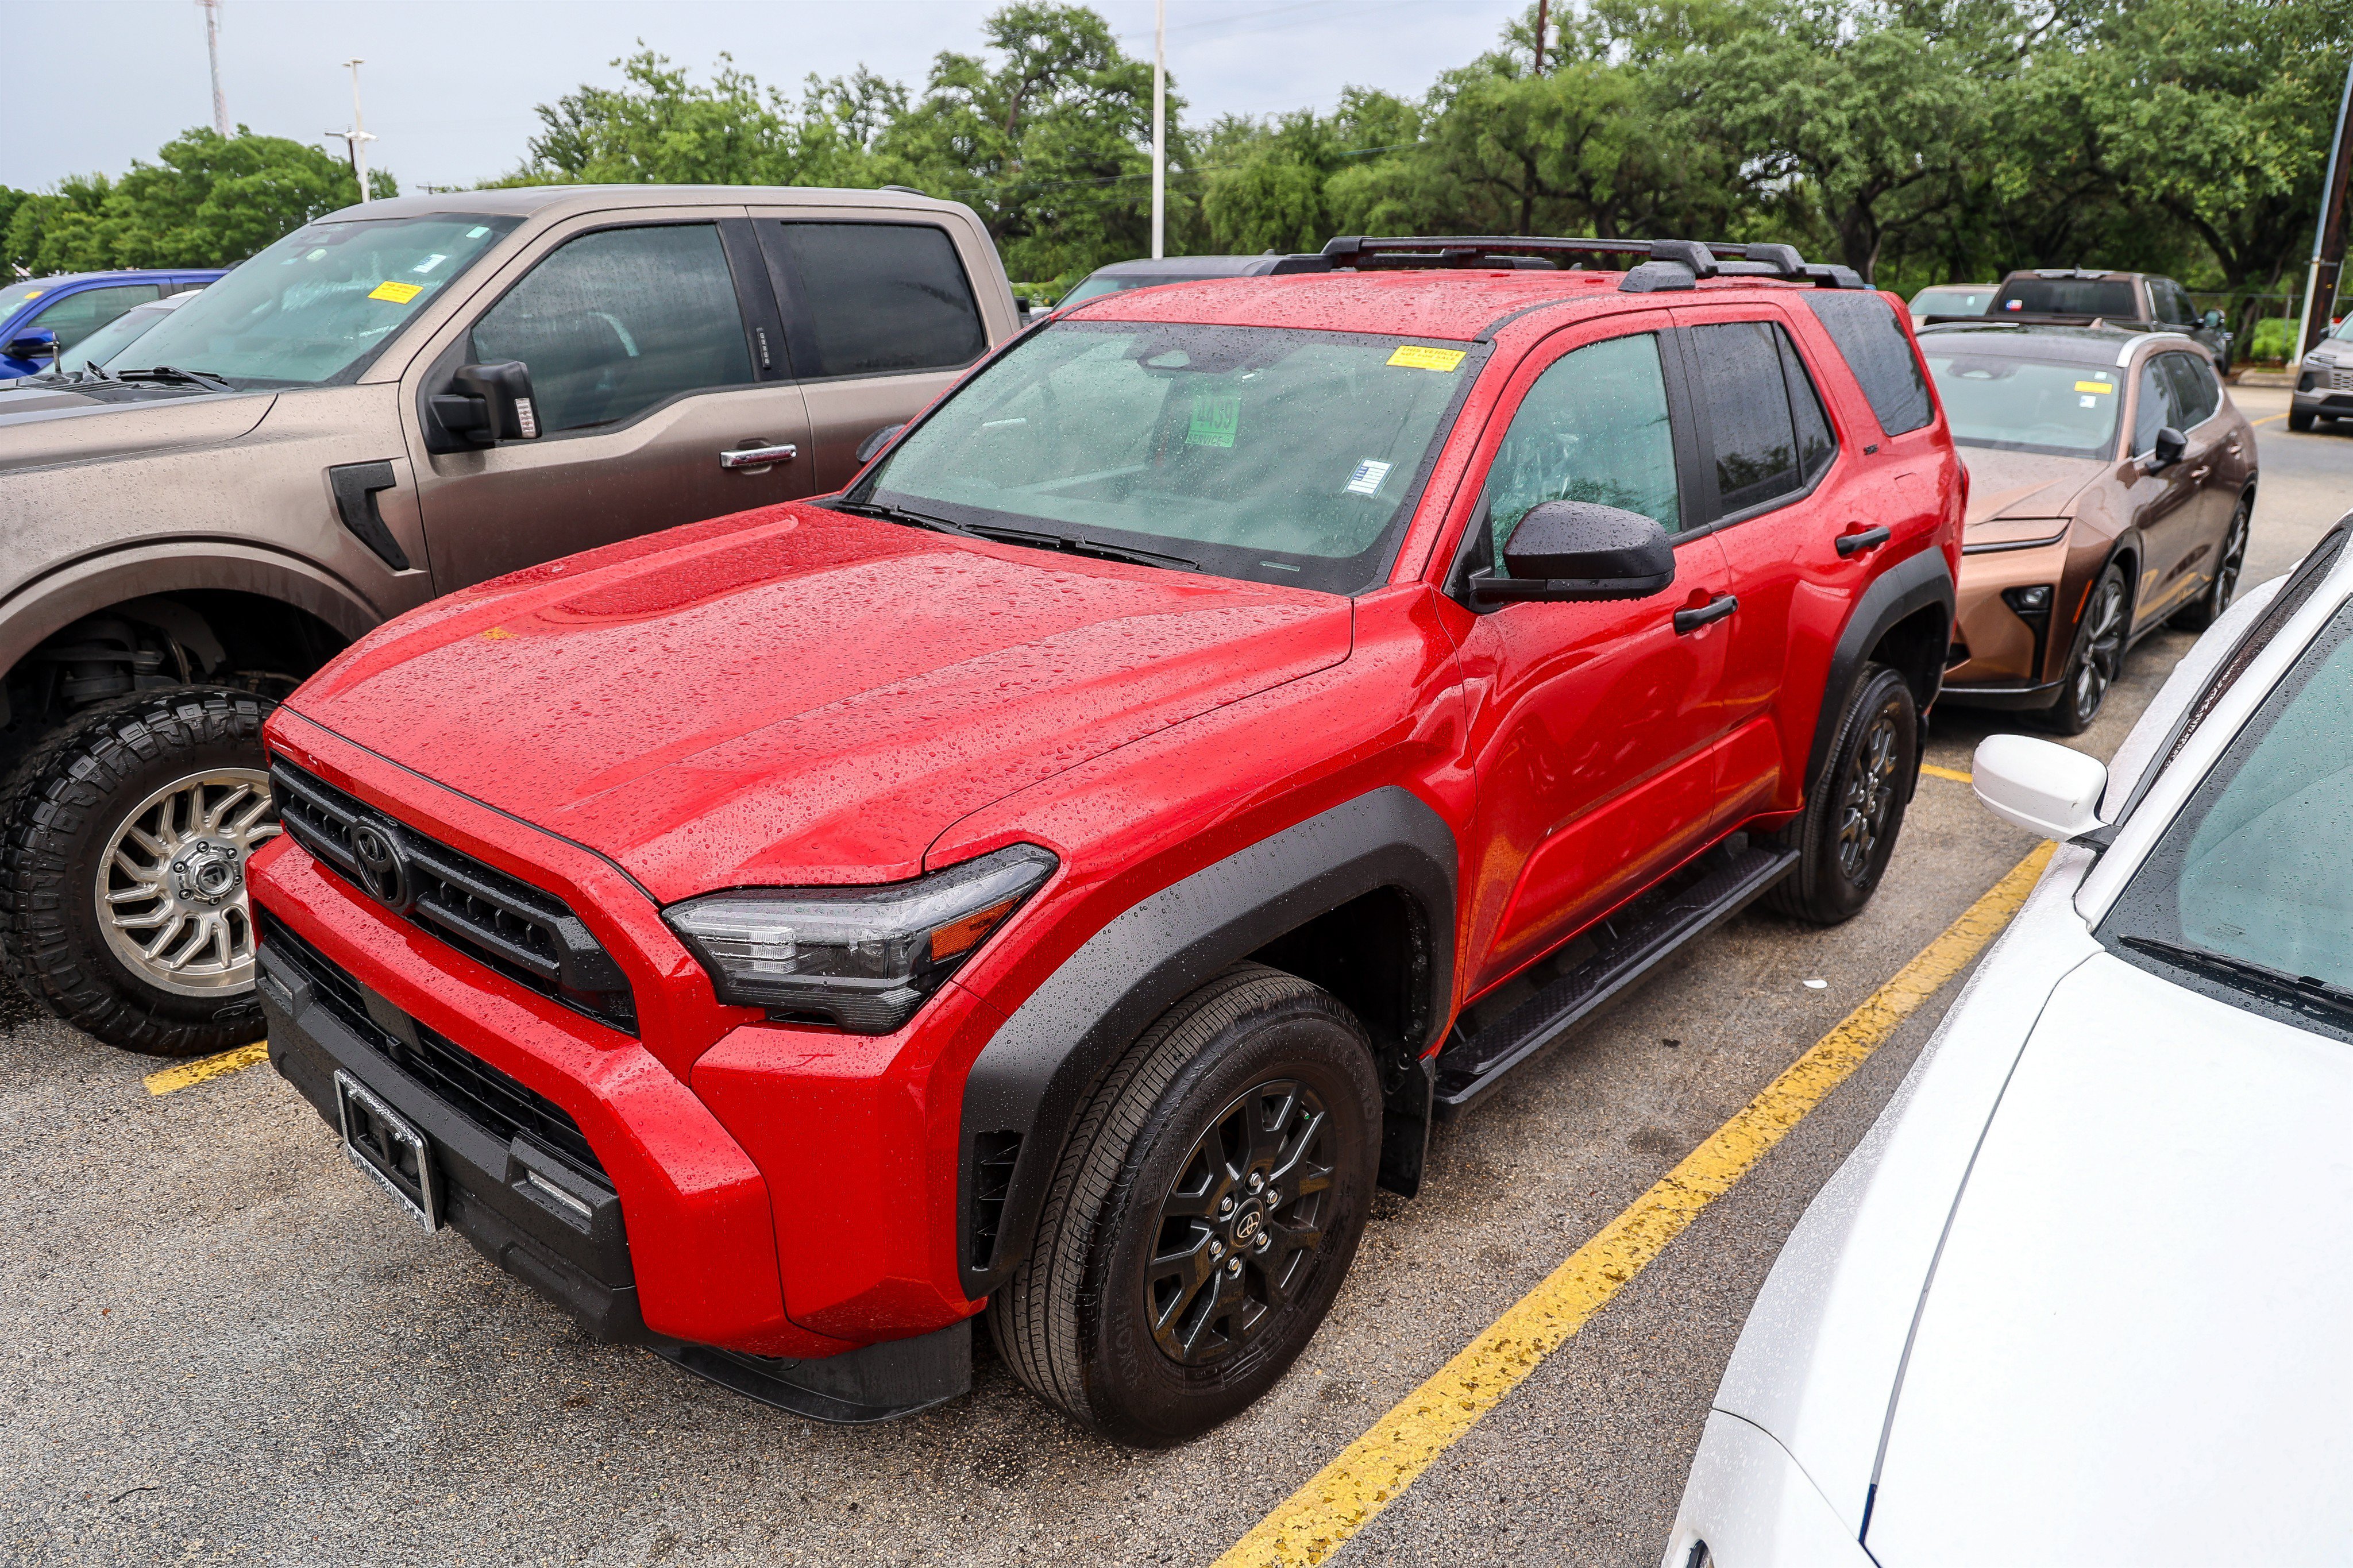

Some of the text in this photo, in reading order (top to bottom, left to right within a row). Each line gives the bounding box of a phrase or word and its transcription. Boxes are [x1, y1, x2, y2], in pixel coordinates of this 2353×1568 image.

[1424, 349, 1460, 357] VEHICLE
[1197, 398, 1233, 430] 4439
[1186, 433, 1224, 446] SERVICE
[99, 838, 121, 878] FUEL
